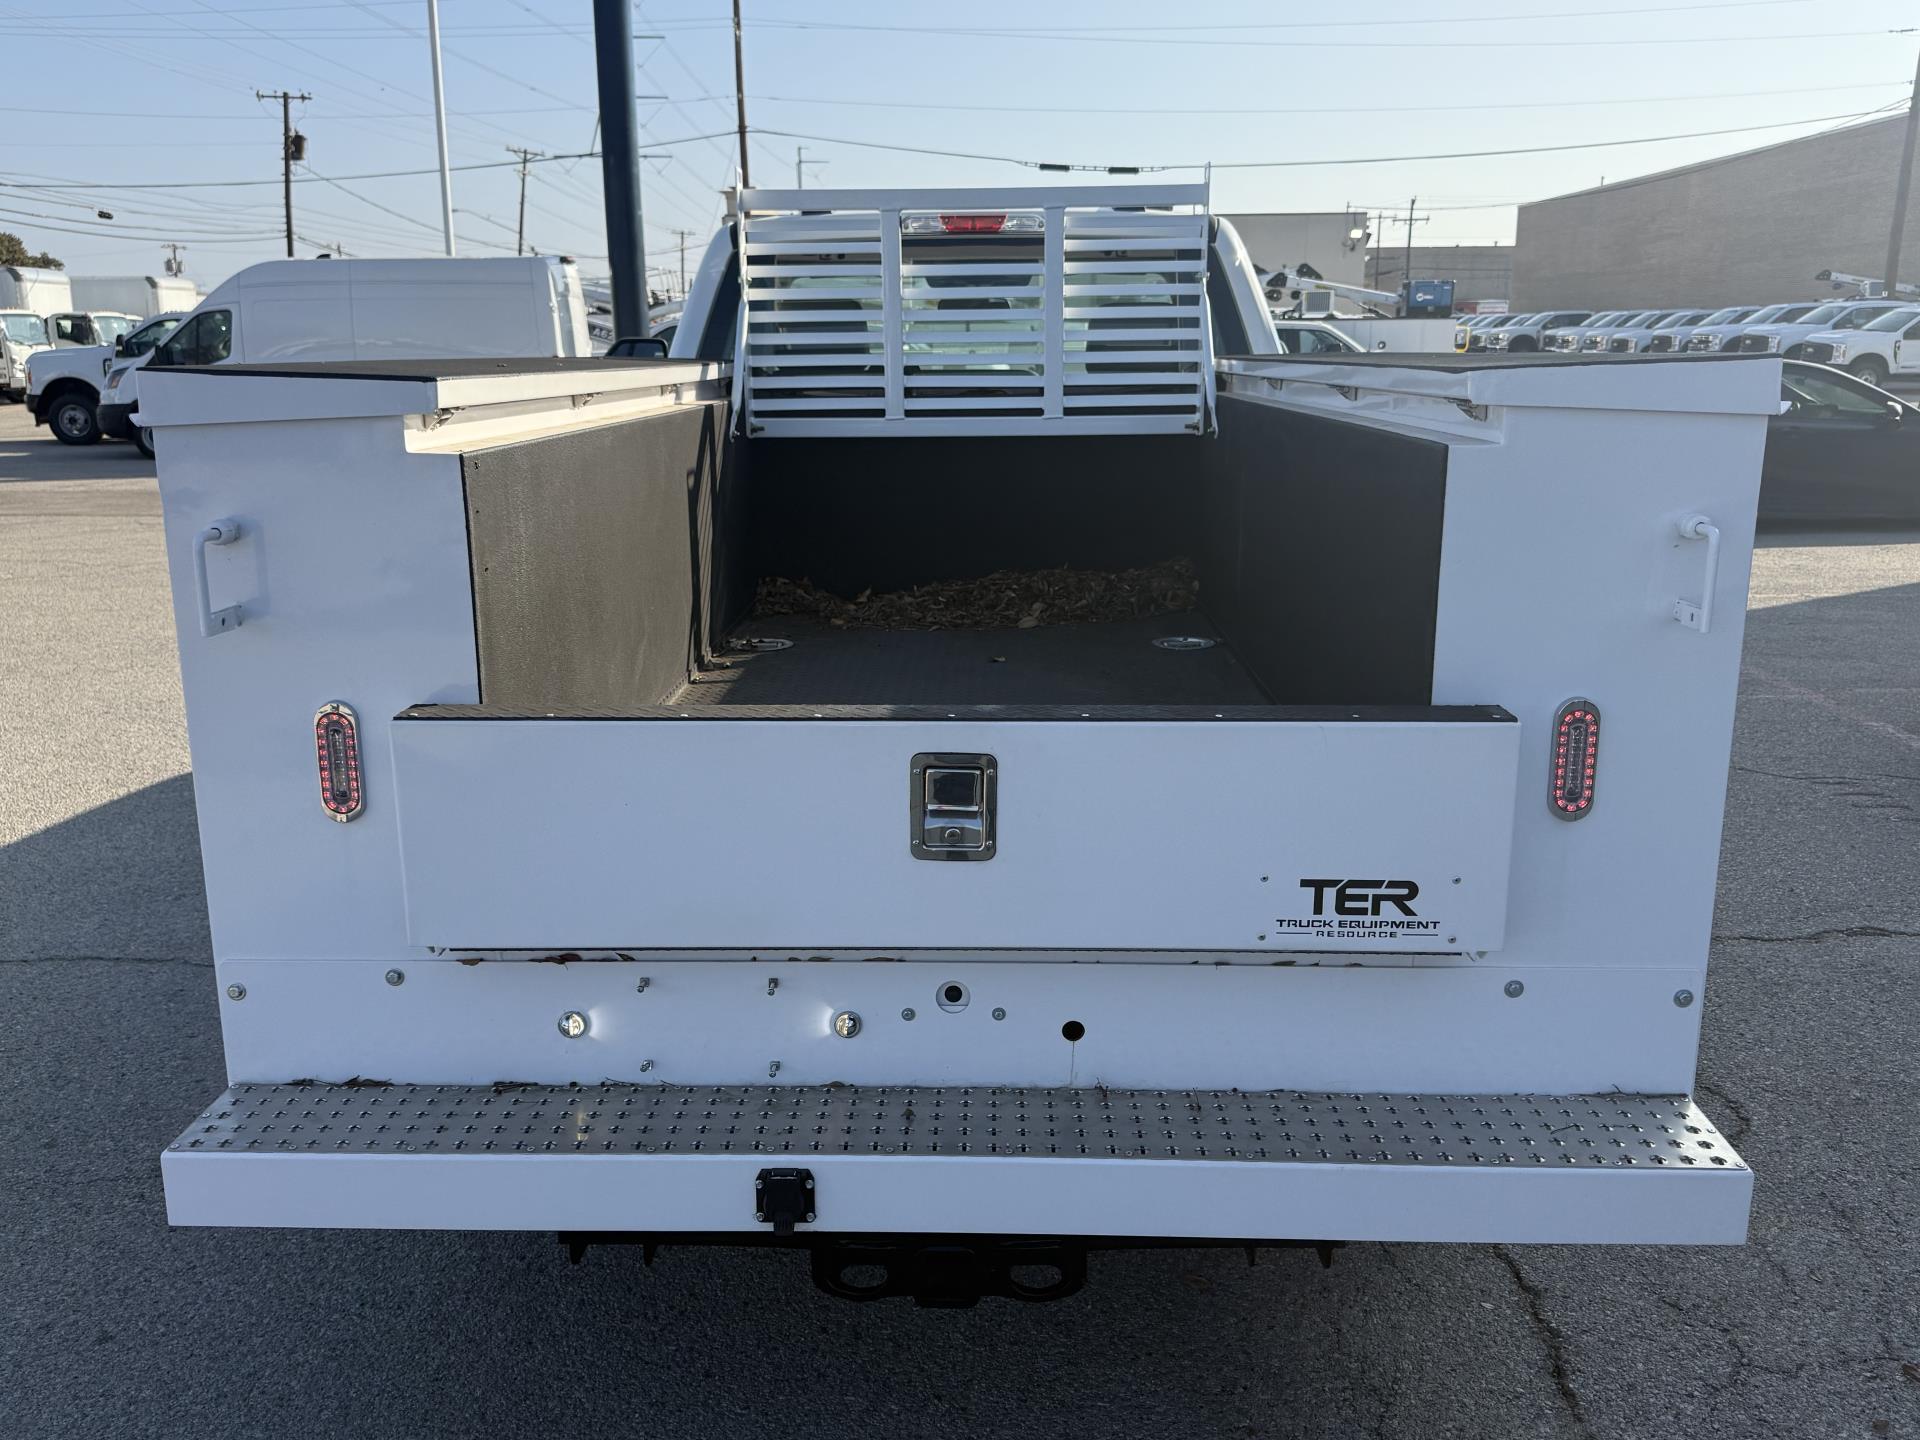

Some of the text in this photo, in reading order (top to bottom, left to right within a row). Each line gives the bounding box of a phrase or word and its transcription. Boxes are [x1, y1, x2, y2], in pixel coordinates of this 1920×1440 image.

[1300, 879, 1419, 916] TER
[1276, 919, 1440, 930] TRUCK EQUIPMENT
[1316, 930, 1397, 938] RESOURCE
